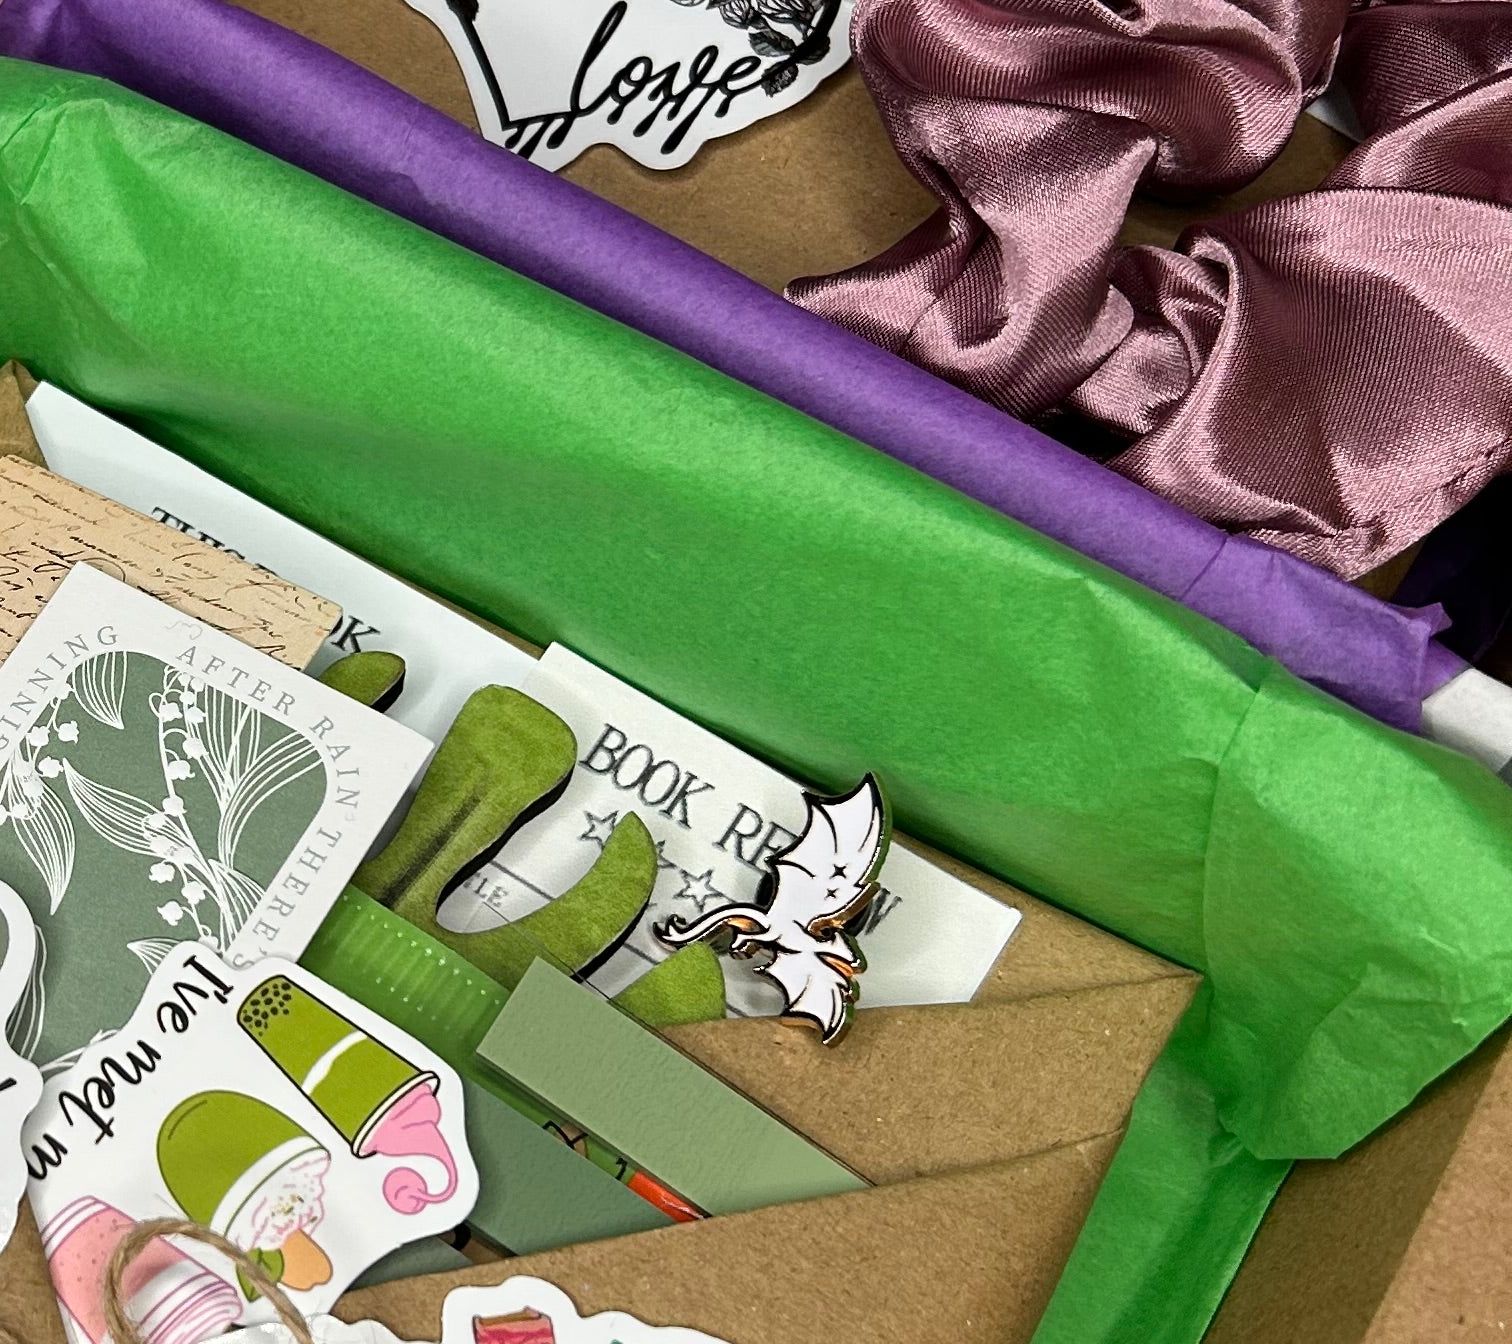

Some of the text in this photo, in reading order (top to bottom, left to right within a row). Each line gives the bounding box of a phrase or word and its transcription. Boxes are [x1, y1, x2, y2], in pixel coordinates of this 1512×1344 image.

[571, 0, 763, 154] love
[176, 645, 297, 717] AFTER
[309, 715, 362, 809] RAIN
[578, 723, 716, 830] BOOK
[157, 956, 235, 1034] I've
[59, 1040, 162, 1144] met
